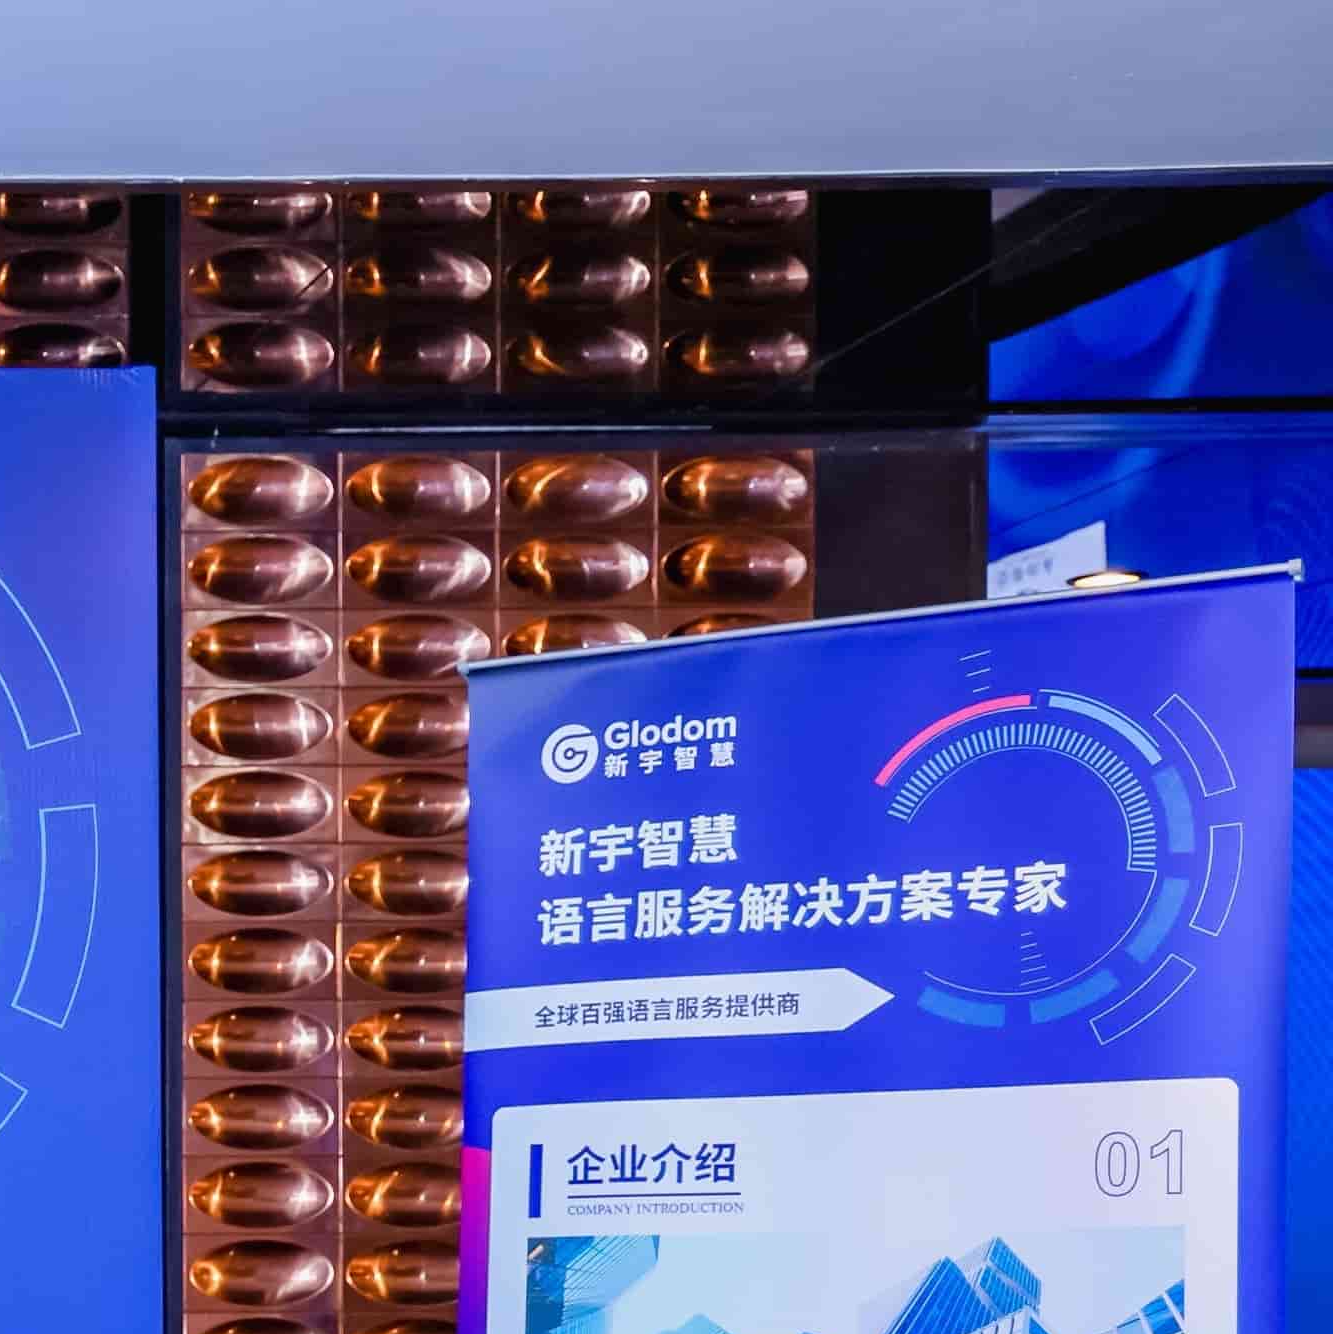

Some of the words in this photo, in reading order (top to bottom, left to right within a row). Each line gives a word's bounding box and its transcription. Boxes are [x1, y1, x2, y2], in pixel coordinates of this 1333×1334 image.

[603, 713, 737, 750] Glodom
[603, 745, 736, 779] 新宇智慧
[538, 812, 739, 878] 新宇智慧
[536, 860, 1070, 947] 语言服务解决方案专家
[535, 992, 800, 1029] 全球百强语言服务提供商
[566, 1141, 737, 1188] 企业介绍
[1093, 1128, 1186, 1198] 01
[567, 1203, 633, 1217] COMPANY
[636, 1201, 745, 1216] INTRODUCTION
